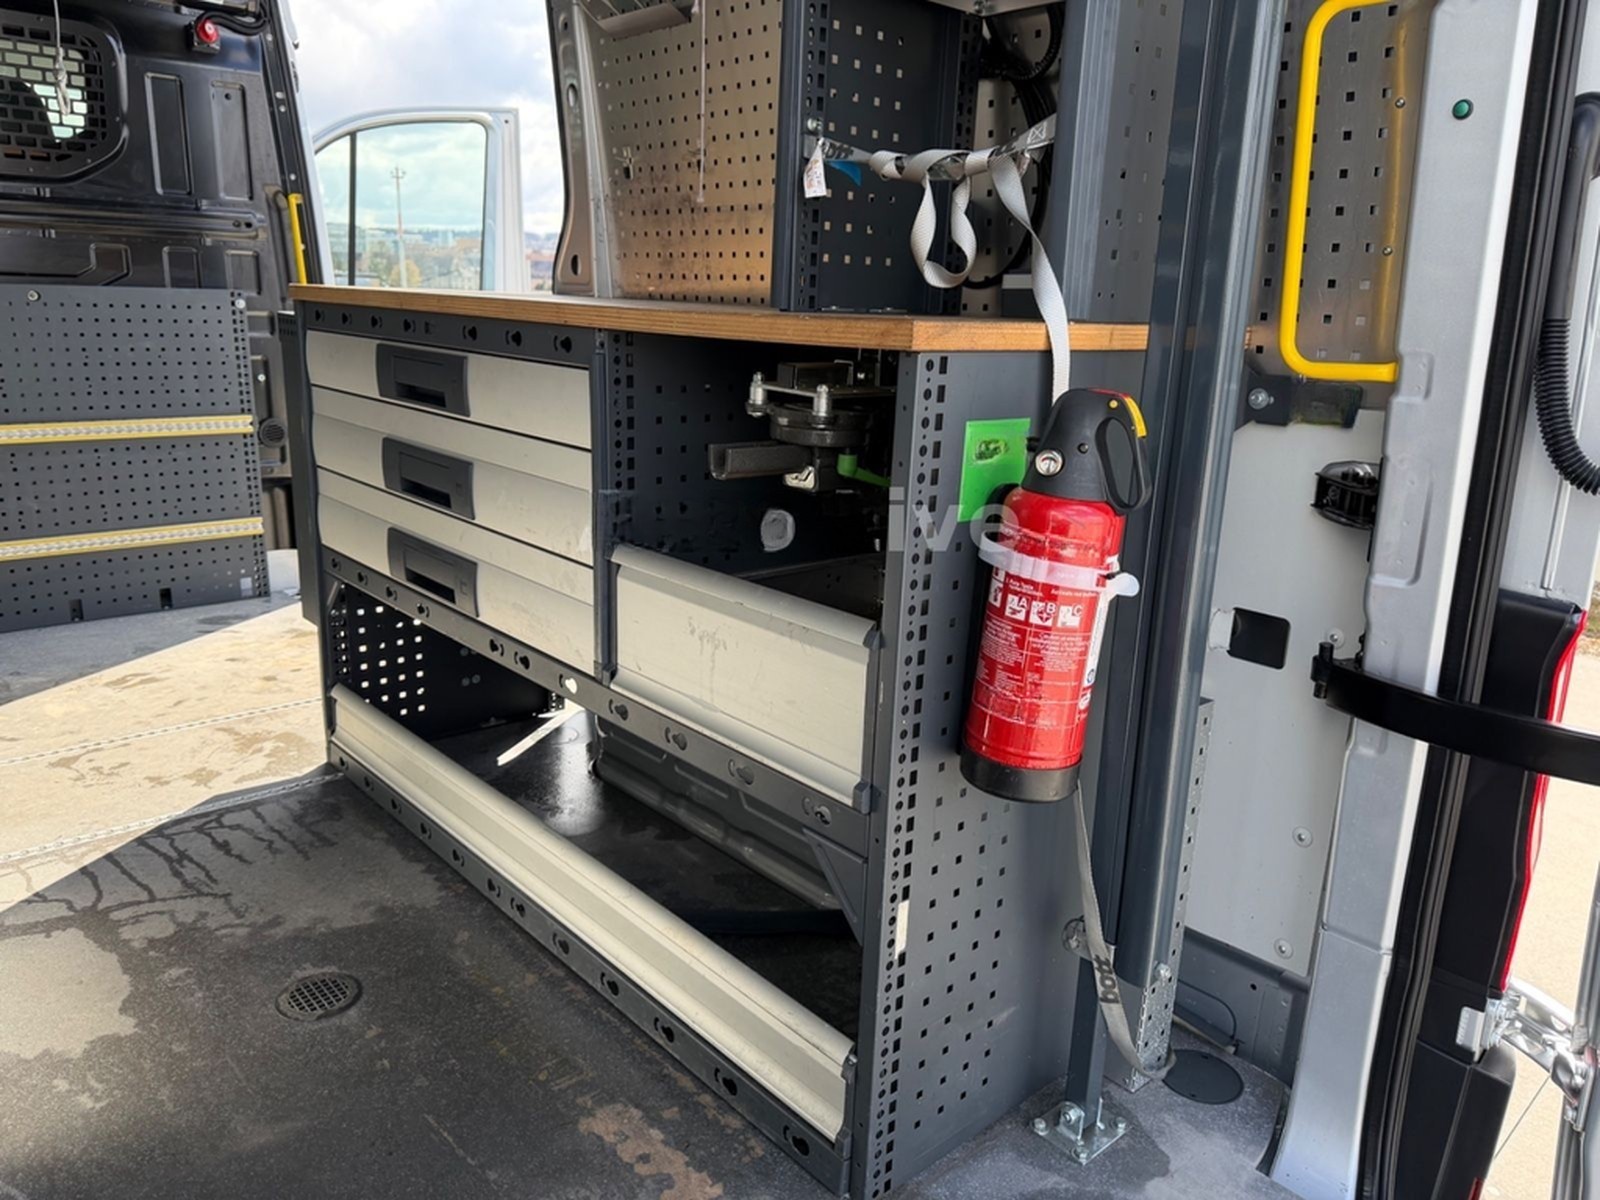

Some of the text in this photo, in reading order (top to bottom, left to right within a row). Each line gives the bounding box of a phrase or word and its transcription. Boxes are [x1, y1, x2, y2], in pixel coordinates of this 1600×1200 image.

[1018, 596, 1029, 609] A
[1045, 602, 1057, 615] B
[1072, 604, 1083, 617] C
[1093, 953, 1121, 1004] bott
